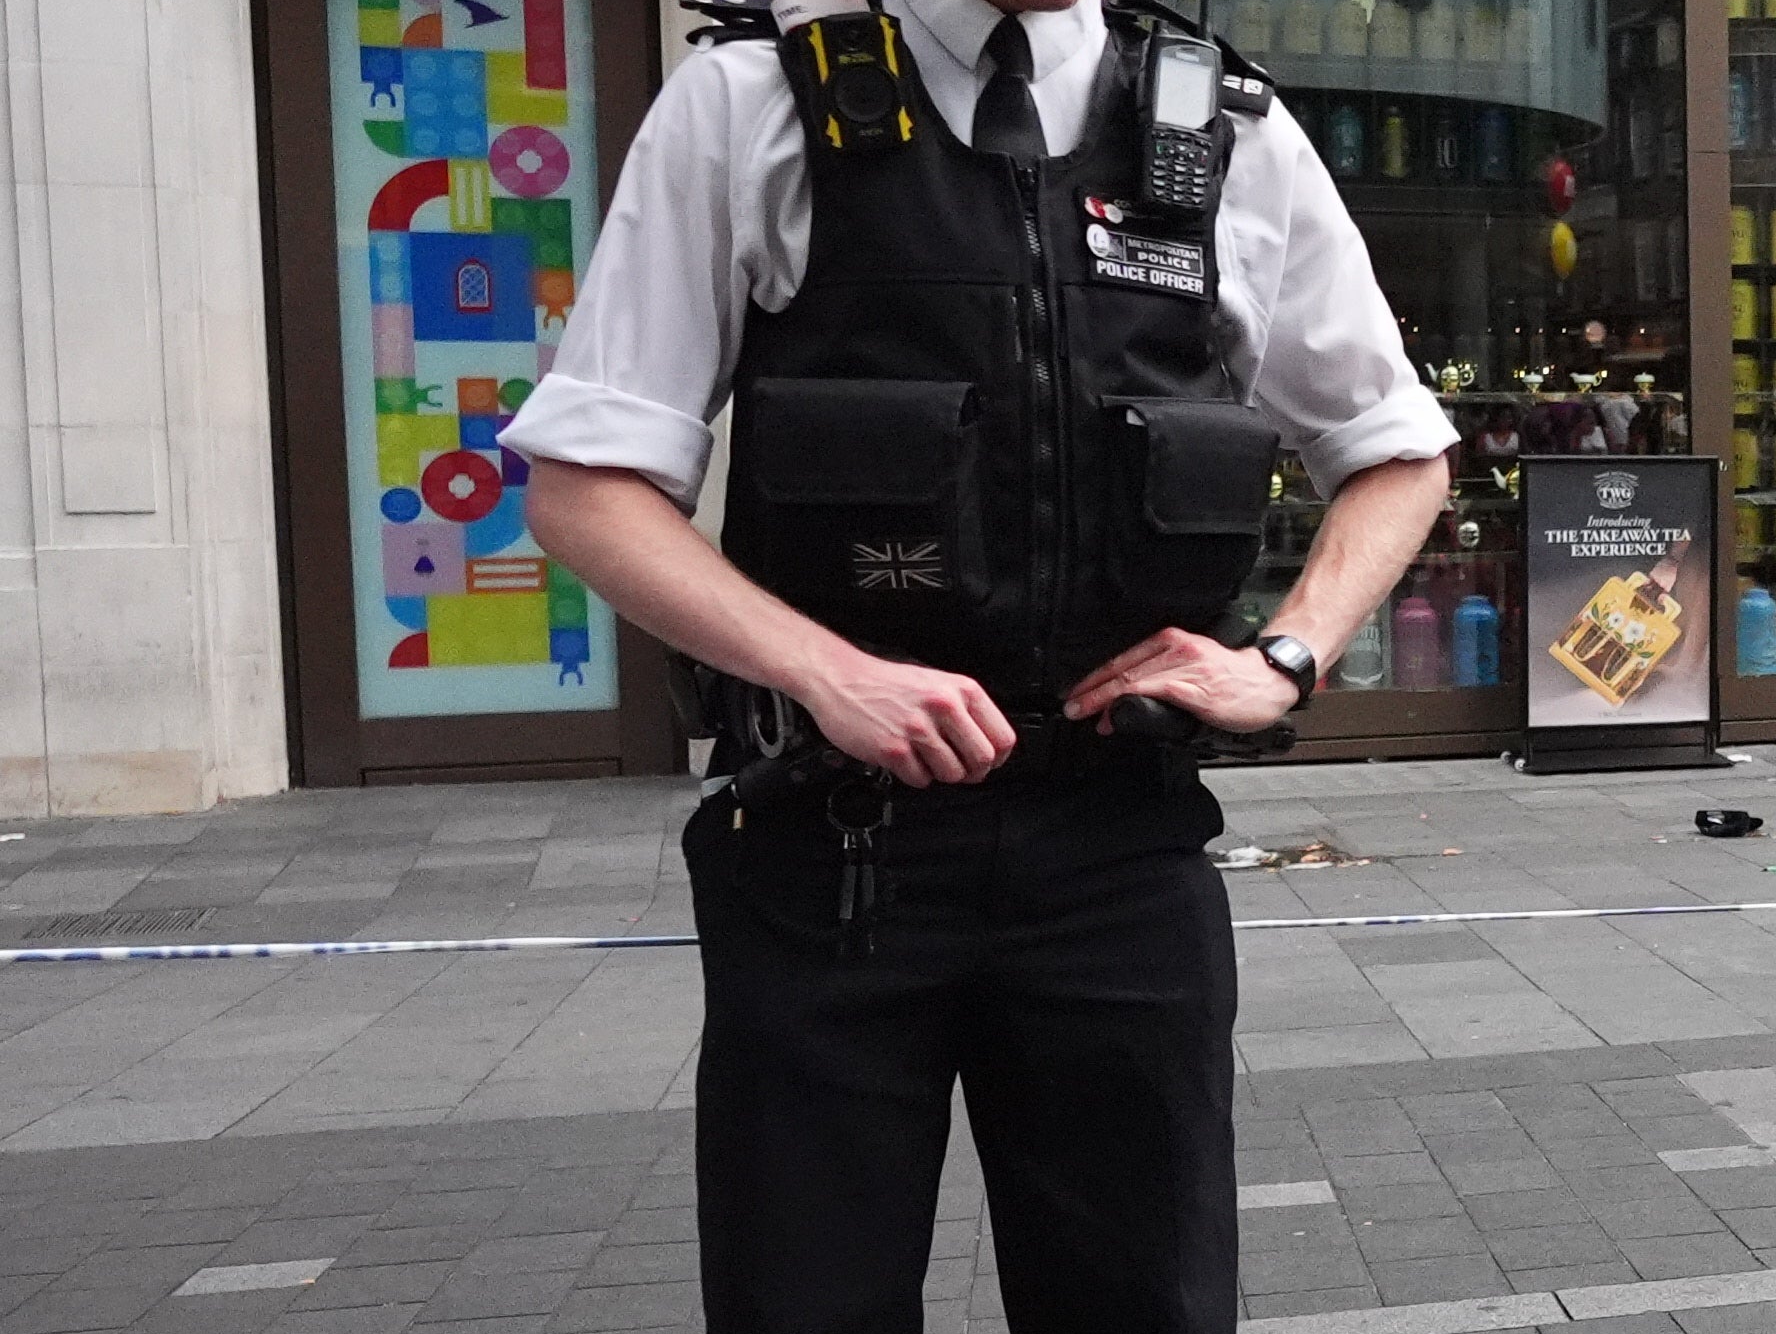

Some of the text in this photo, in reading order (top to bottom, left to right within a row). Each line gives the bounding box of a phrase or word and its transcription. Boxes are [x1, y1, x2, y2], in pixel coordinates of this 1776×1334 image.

[1127, 238, 1199, 260] METROPOLITAN
[1137, 251, 1191, 270] POLICE
[1096, 260, 1204, 295] POLICE OFFICER
[1599, 487, 1632, 499] TWG
[1586, 515, 1652, 529] Introducing
[1545, 528, 1692, 543] THE TAKEAWAY TEA
[1570, 543, 1667, 557] EXPERIENCE
